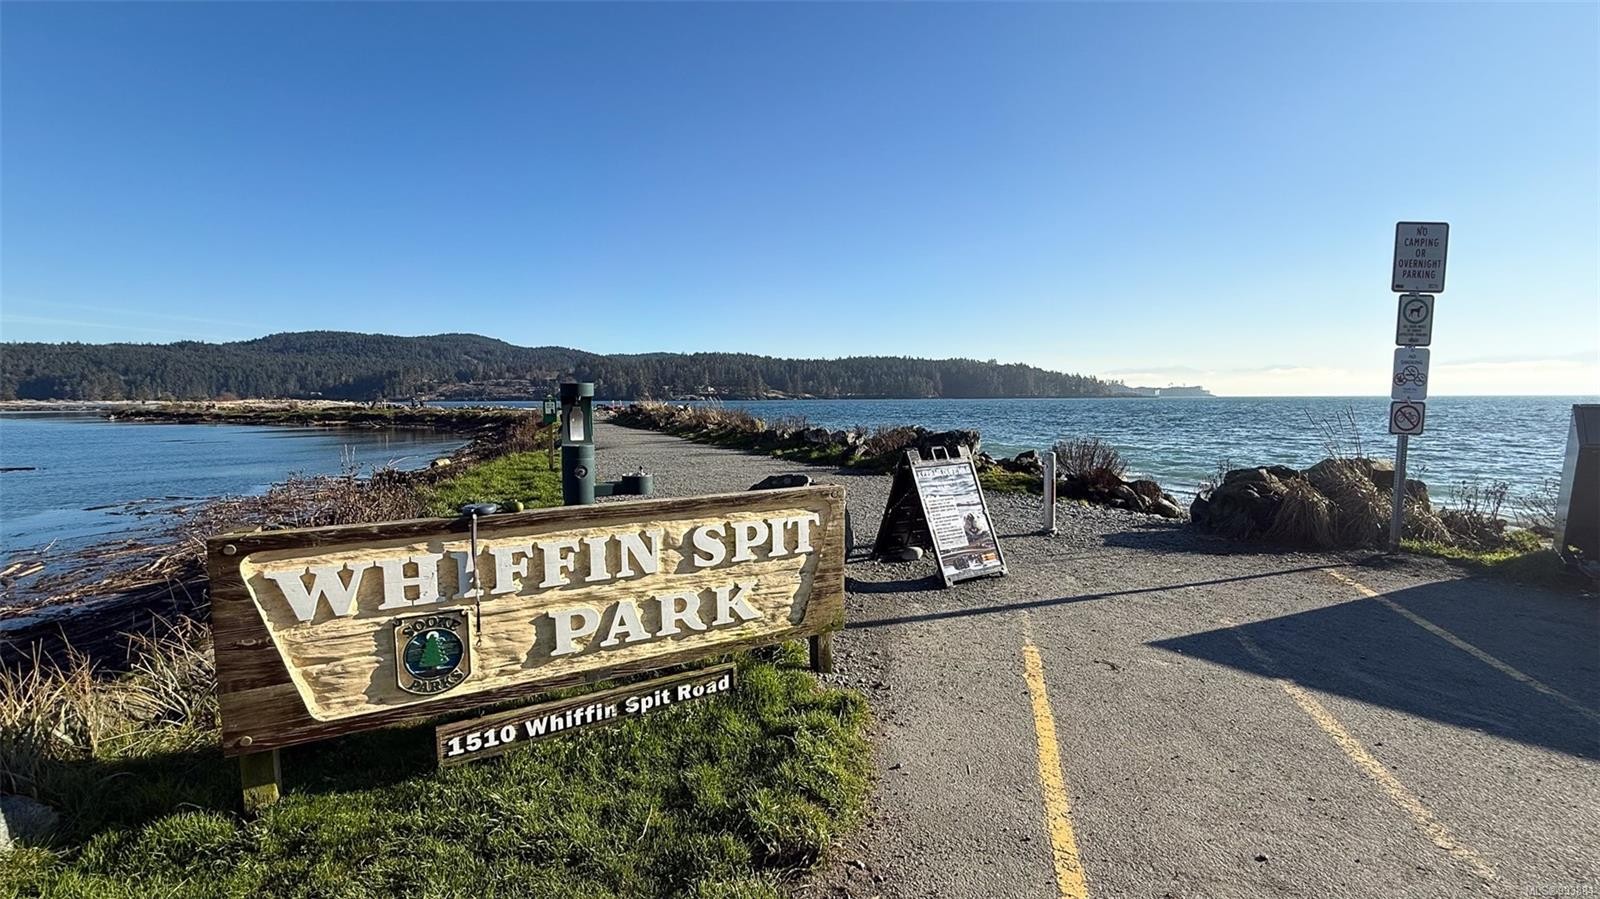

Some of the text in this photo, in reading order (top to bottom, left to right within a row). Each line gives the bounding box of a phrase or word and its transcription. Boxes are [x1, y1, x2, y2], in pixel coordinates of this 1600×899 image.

[1416, 226, 1428, 236] NO
[1404, 237, 1440, 247] CAMPING
[1415, 249, 1426, 258] OR
[1398, 258, 1441, 269] OVERNIGHT
[1402, 270, 1436, 279] PARKING
[263, 512, 821, 622] WHIFFIN SPIT
[548, 580, 762, 657] PARK
[409, 667, 465, 692] PARKS
[447, 674, 730, 757] 1510 Whiffin Spit Road
